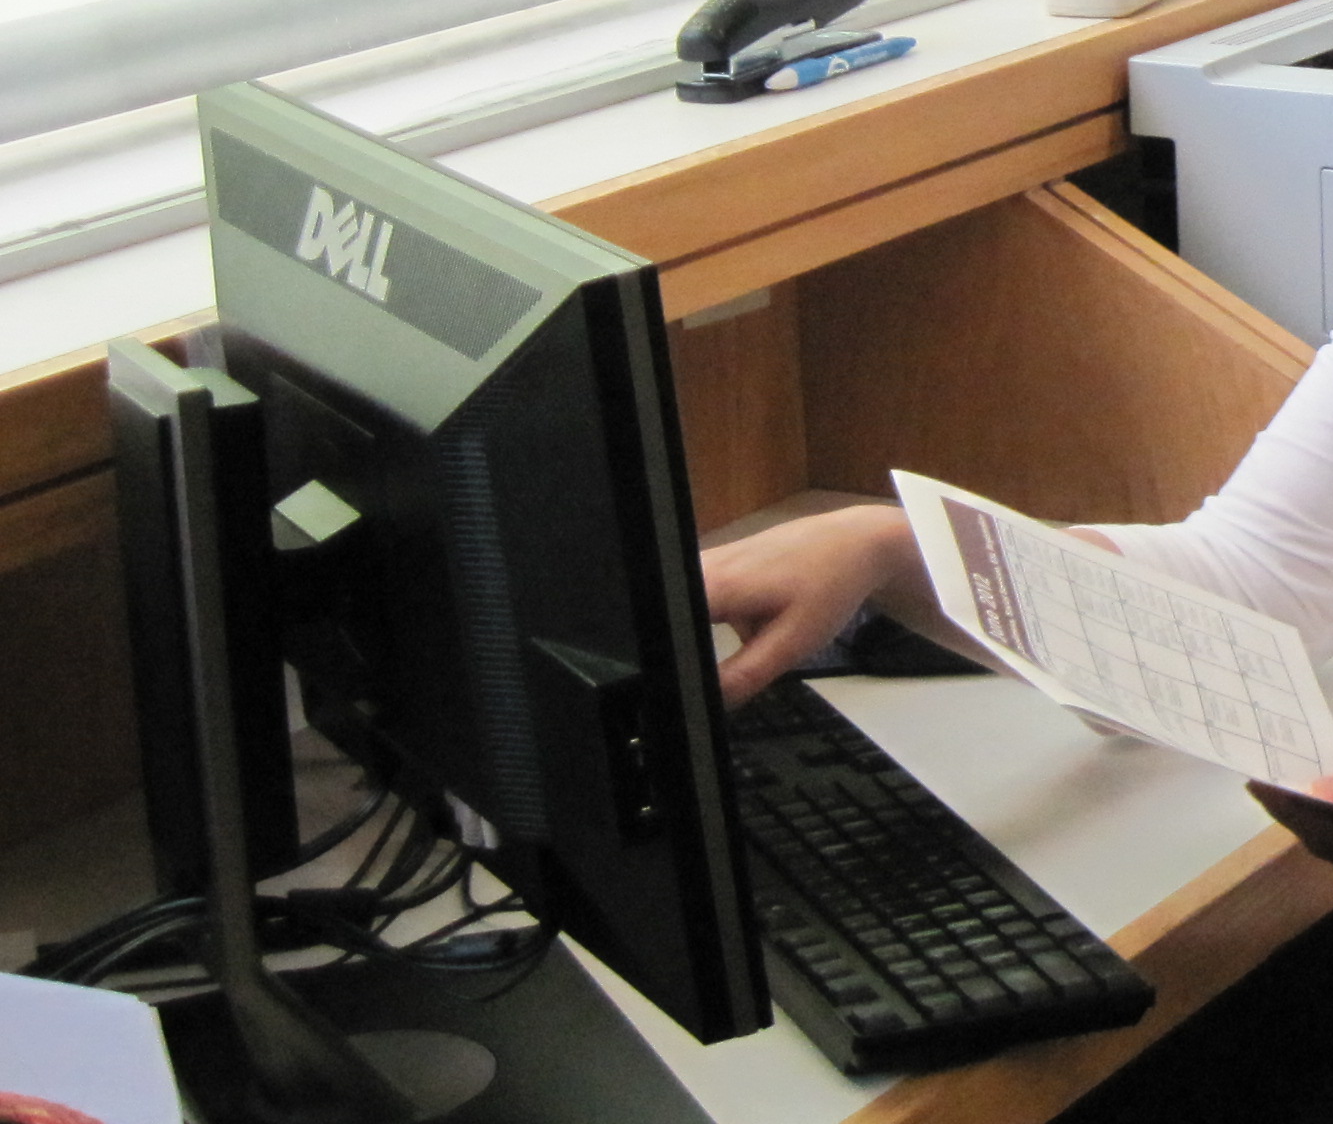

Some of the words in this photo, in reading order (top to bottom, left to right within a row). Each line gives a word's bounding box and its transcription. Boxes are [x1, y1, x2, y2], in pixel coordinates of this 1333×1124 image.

[297, 186, 394, 301] DELL
[973, 573, 997, 609] 2012
[986, 609, 1007, 643] June
